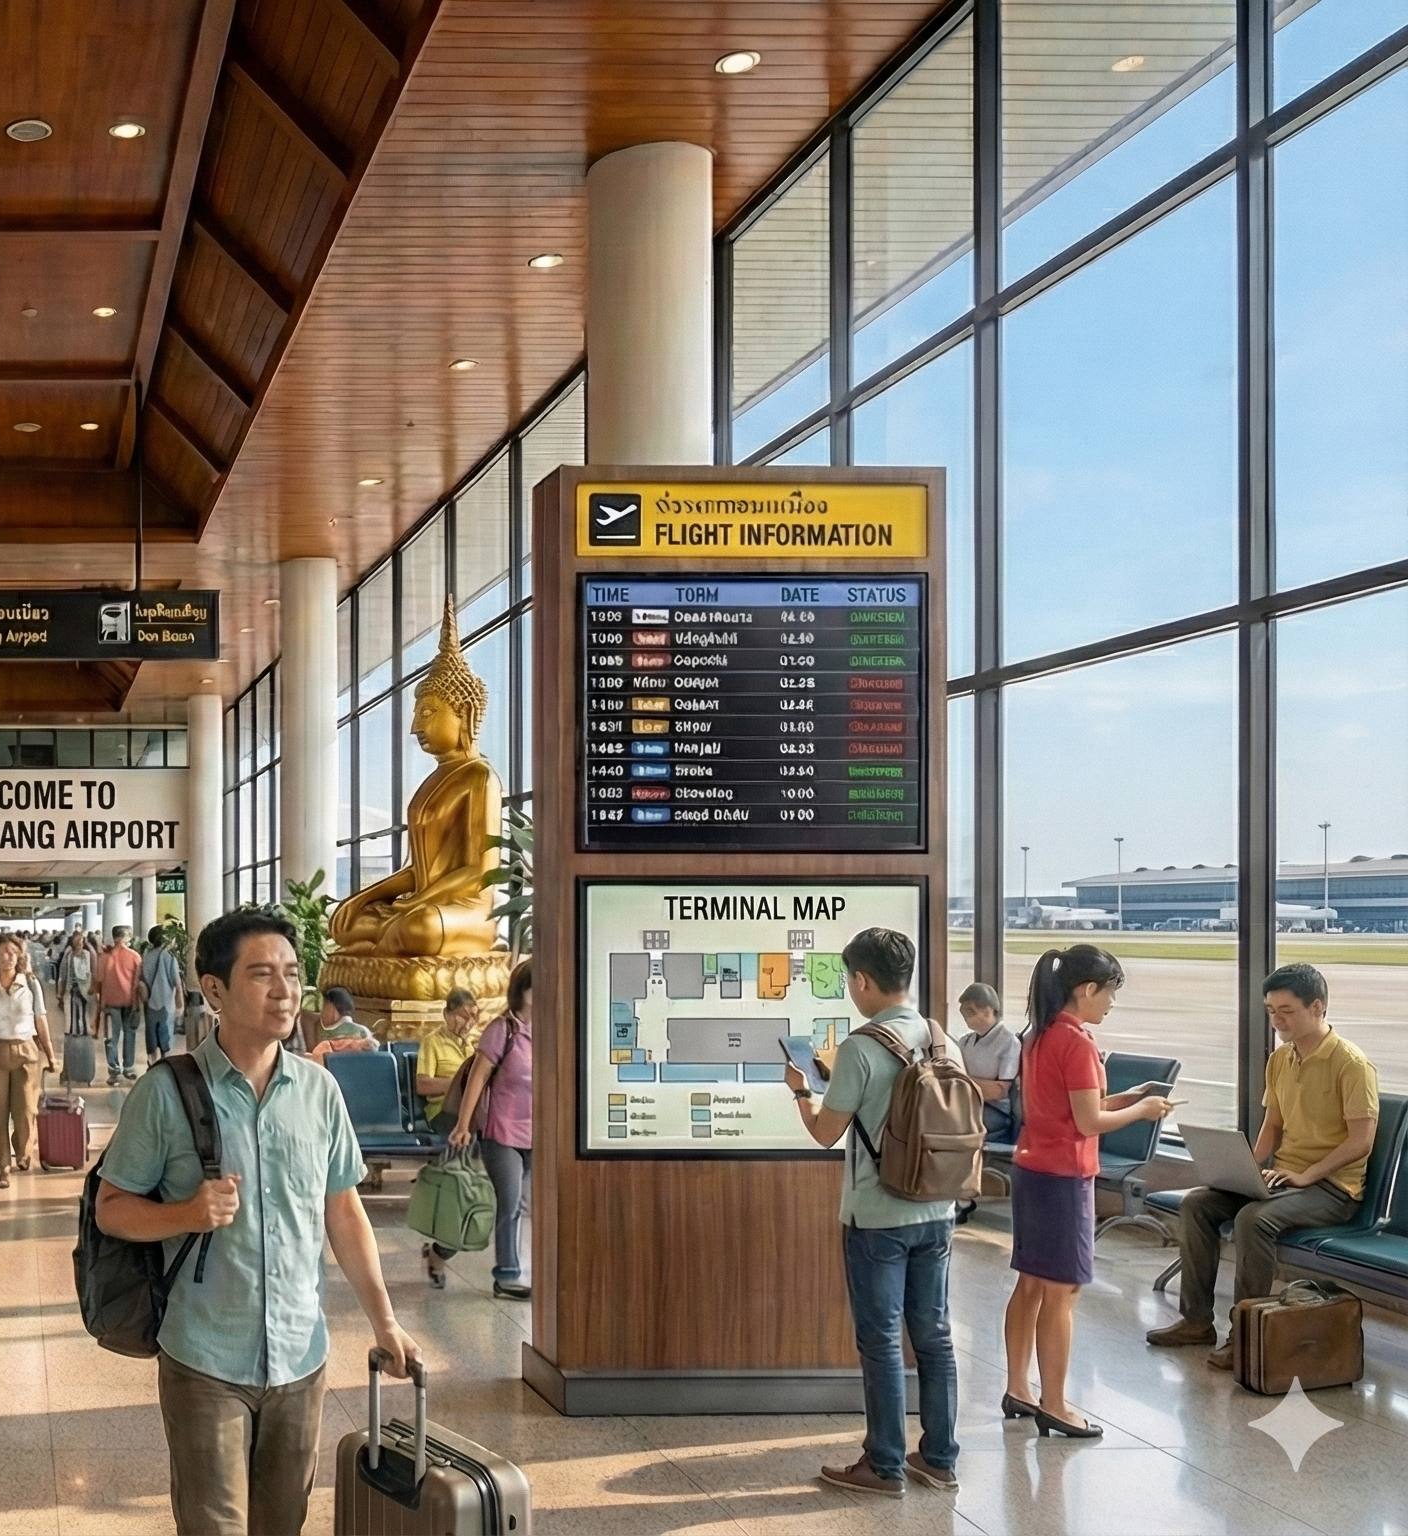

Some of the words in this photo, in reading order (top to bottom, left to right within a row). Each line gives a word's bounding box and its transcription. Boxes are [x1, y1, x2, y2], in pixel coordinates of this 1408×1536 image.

[655, 523, 733, 546] FLIGHT
[741, 523, 893, 547] INFORMATION
[592, 587, 630, 602] TIME
[781, 587, 820, 602] DATE
[847, 587, 907, 602] STATUS
[80, 779, 116, 810] TO
[63, 819, 180, 850] AIRPORT
[663, 896, 787, 921] TERMINAL
[792, 896, 846, 921] MAP
